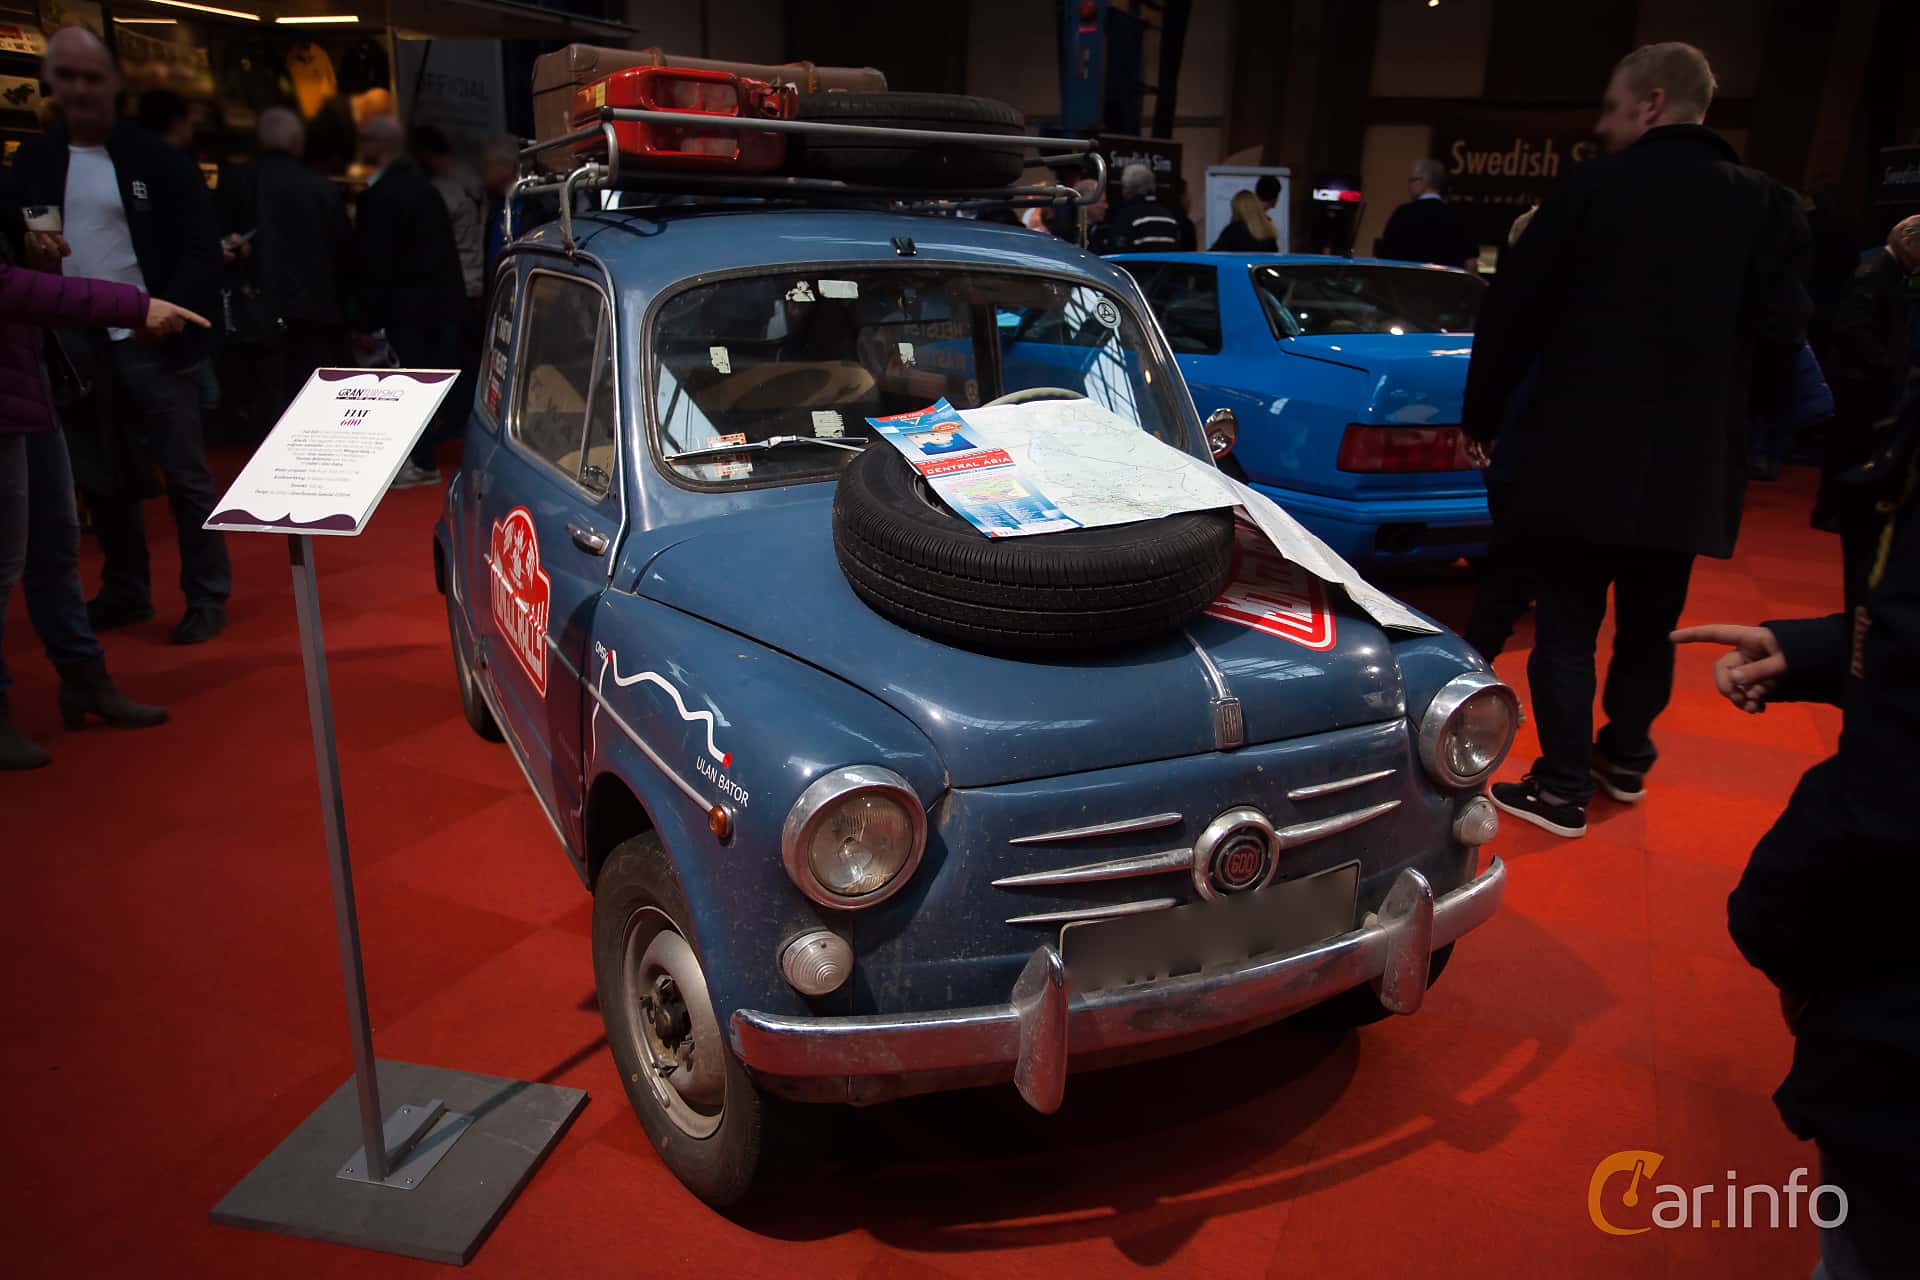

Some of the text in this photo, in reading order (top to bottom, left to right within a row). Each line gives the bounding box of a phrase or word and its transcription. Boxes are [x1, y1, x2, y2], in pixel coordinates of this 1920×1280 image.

[1450, 137, 1561, 176] Swedish
[340, 418, 362, 427] 600
[926, 457, 1010, 474] CENTRAL ASIA
[696, 755, 750, 807] ULAN BATOR
[1231, 852, 1256, 874] 600
